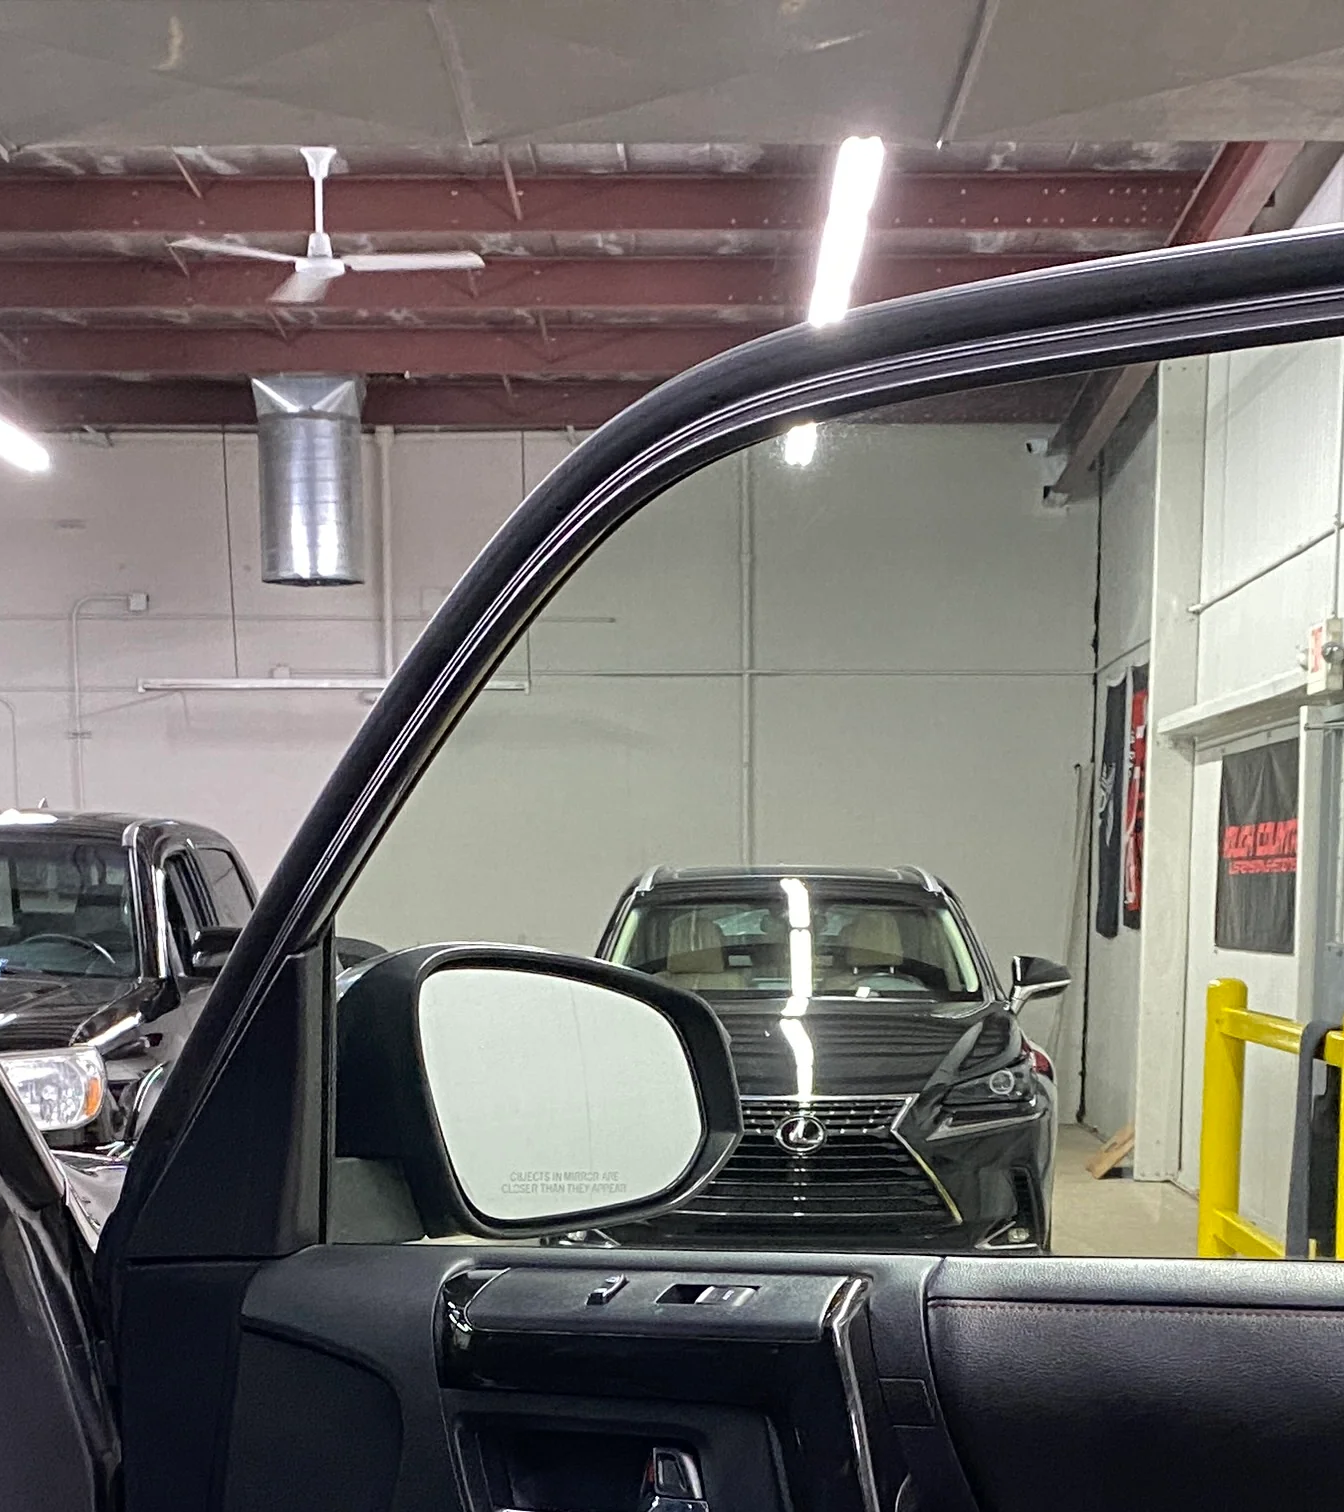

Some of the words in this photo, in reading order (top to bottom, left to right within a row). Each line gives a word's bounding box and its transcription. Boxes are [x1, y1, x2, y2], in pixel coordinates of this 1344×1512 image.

[510, 1171, 550, 1182] OBJECTS
[552, 1171, 563, 1182] IN
[564, 1171, 600, 1182] MIRROR
[602, 1171, 619, 1182] ARE
[501, 1183, 538, 1194] CLOSER
[540, 1183, 566, 1194] THAN
[567, 1183, 590, 1194] THEY
[591, 1183, 627, 1194] APPEAR
